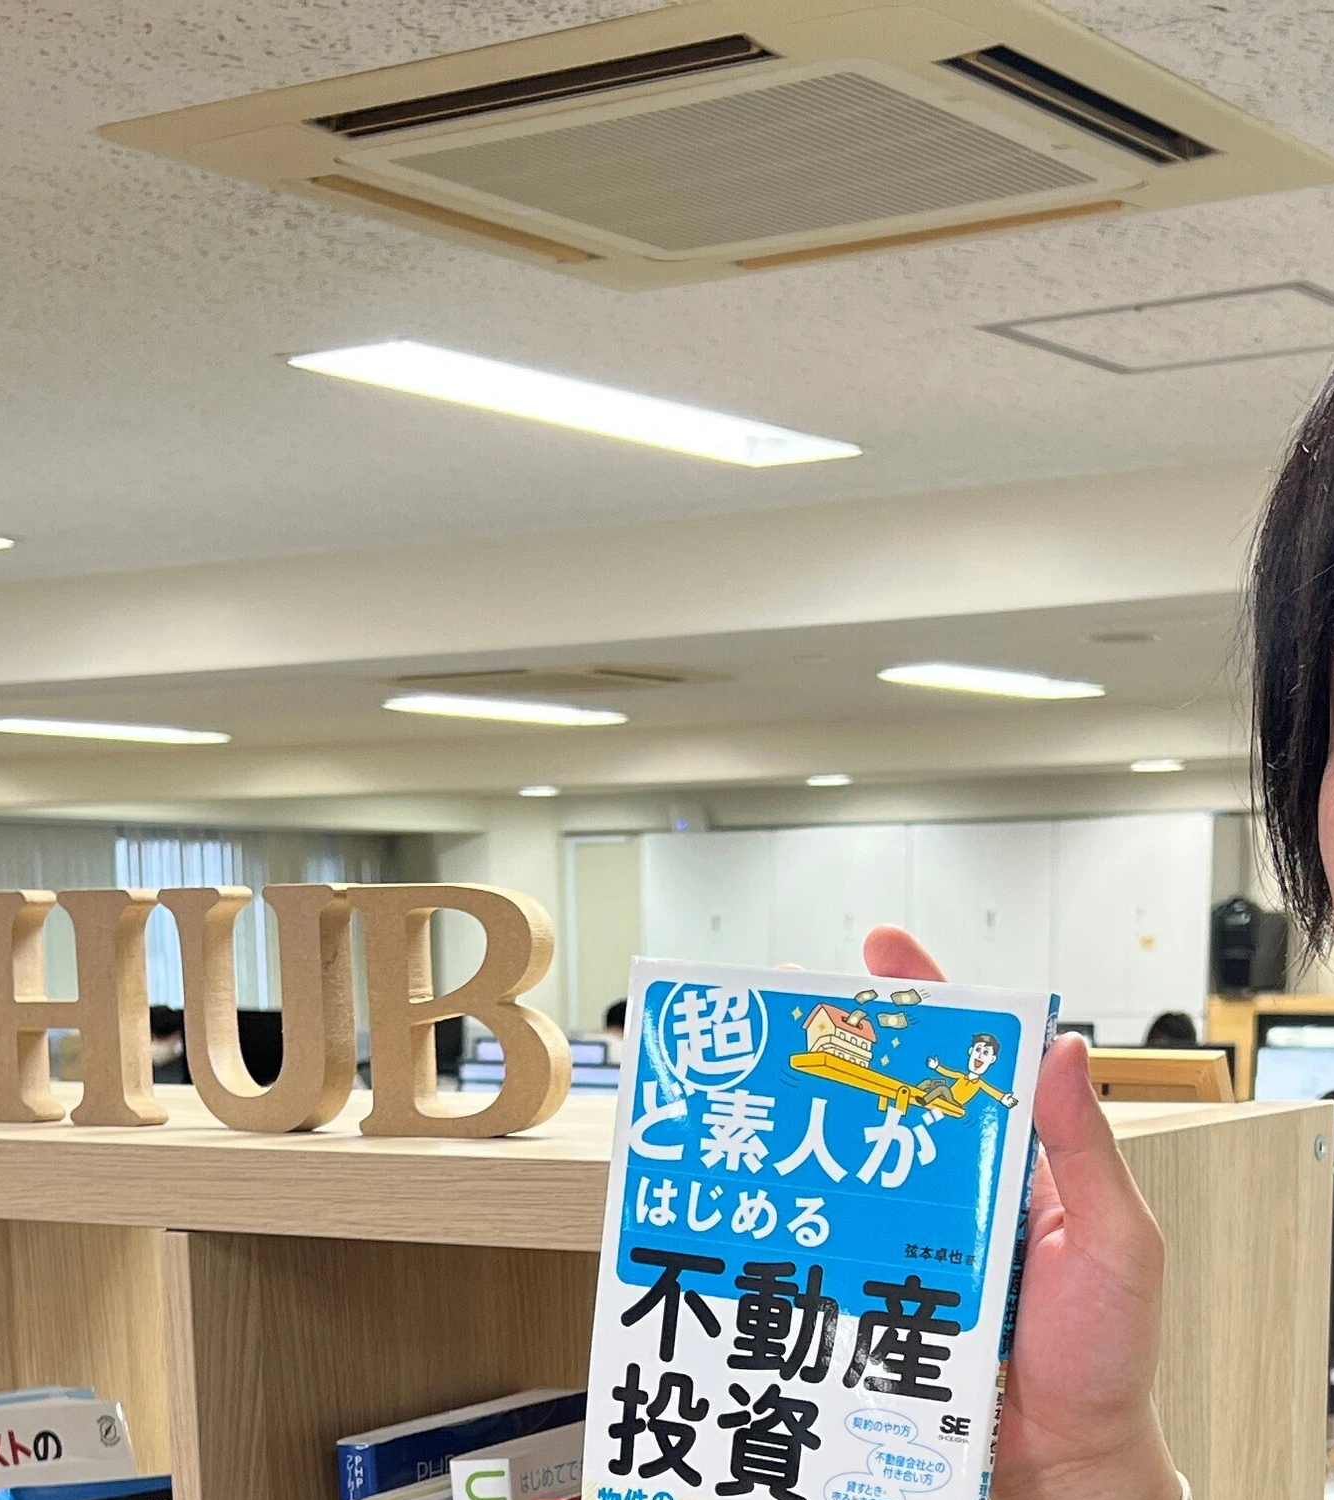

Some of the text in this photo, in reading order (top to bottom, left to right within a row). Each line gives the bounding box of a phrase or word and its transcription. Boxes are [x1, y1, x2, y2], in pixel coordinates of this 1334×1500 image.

[668, 987, 754, 1083] 超
[627, 1081, 943, 1188] ど素人が
[634, 1176, 830, 1246] はじめる
[621, 1246, 961, 1402] 不動産
[852, 1417, 911, 1438] 契約のやり方
[939, 1414, 971, 1436] SE
[875, 1452, 945, 1473] 不動産会社との
[883, 1466, 933, 1486] 付き合い方
